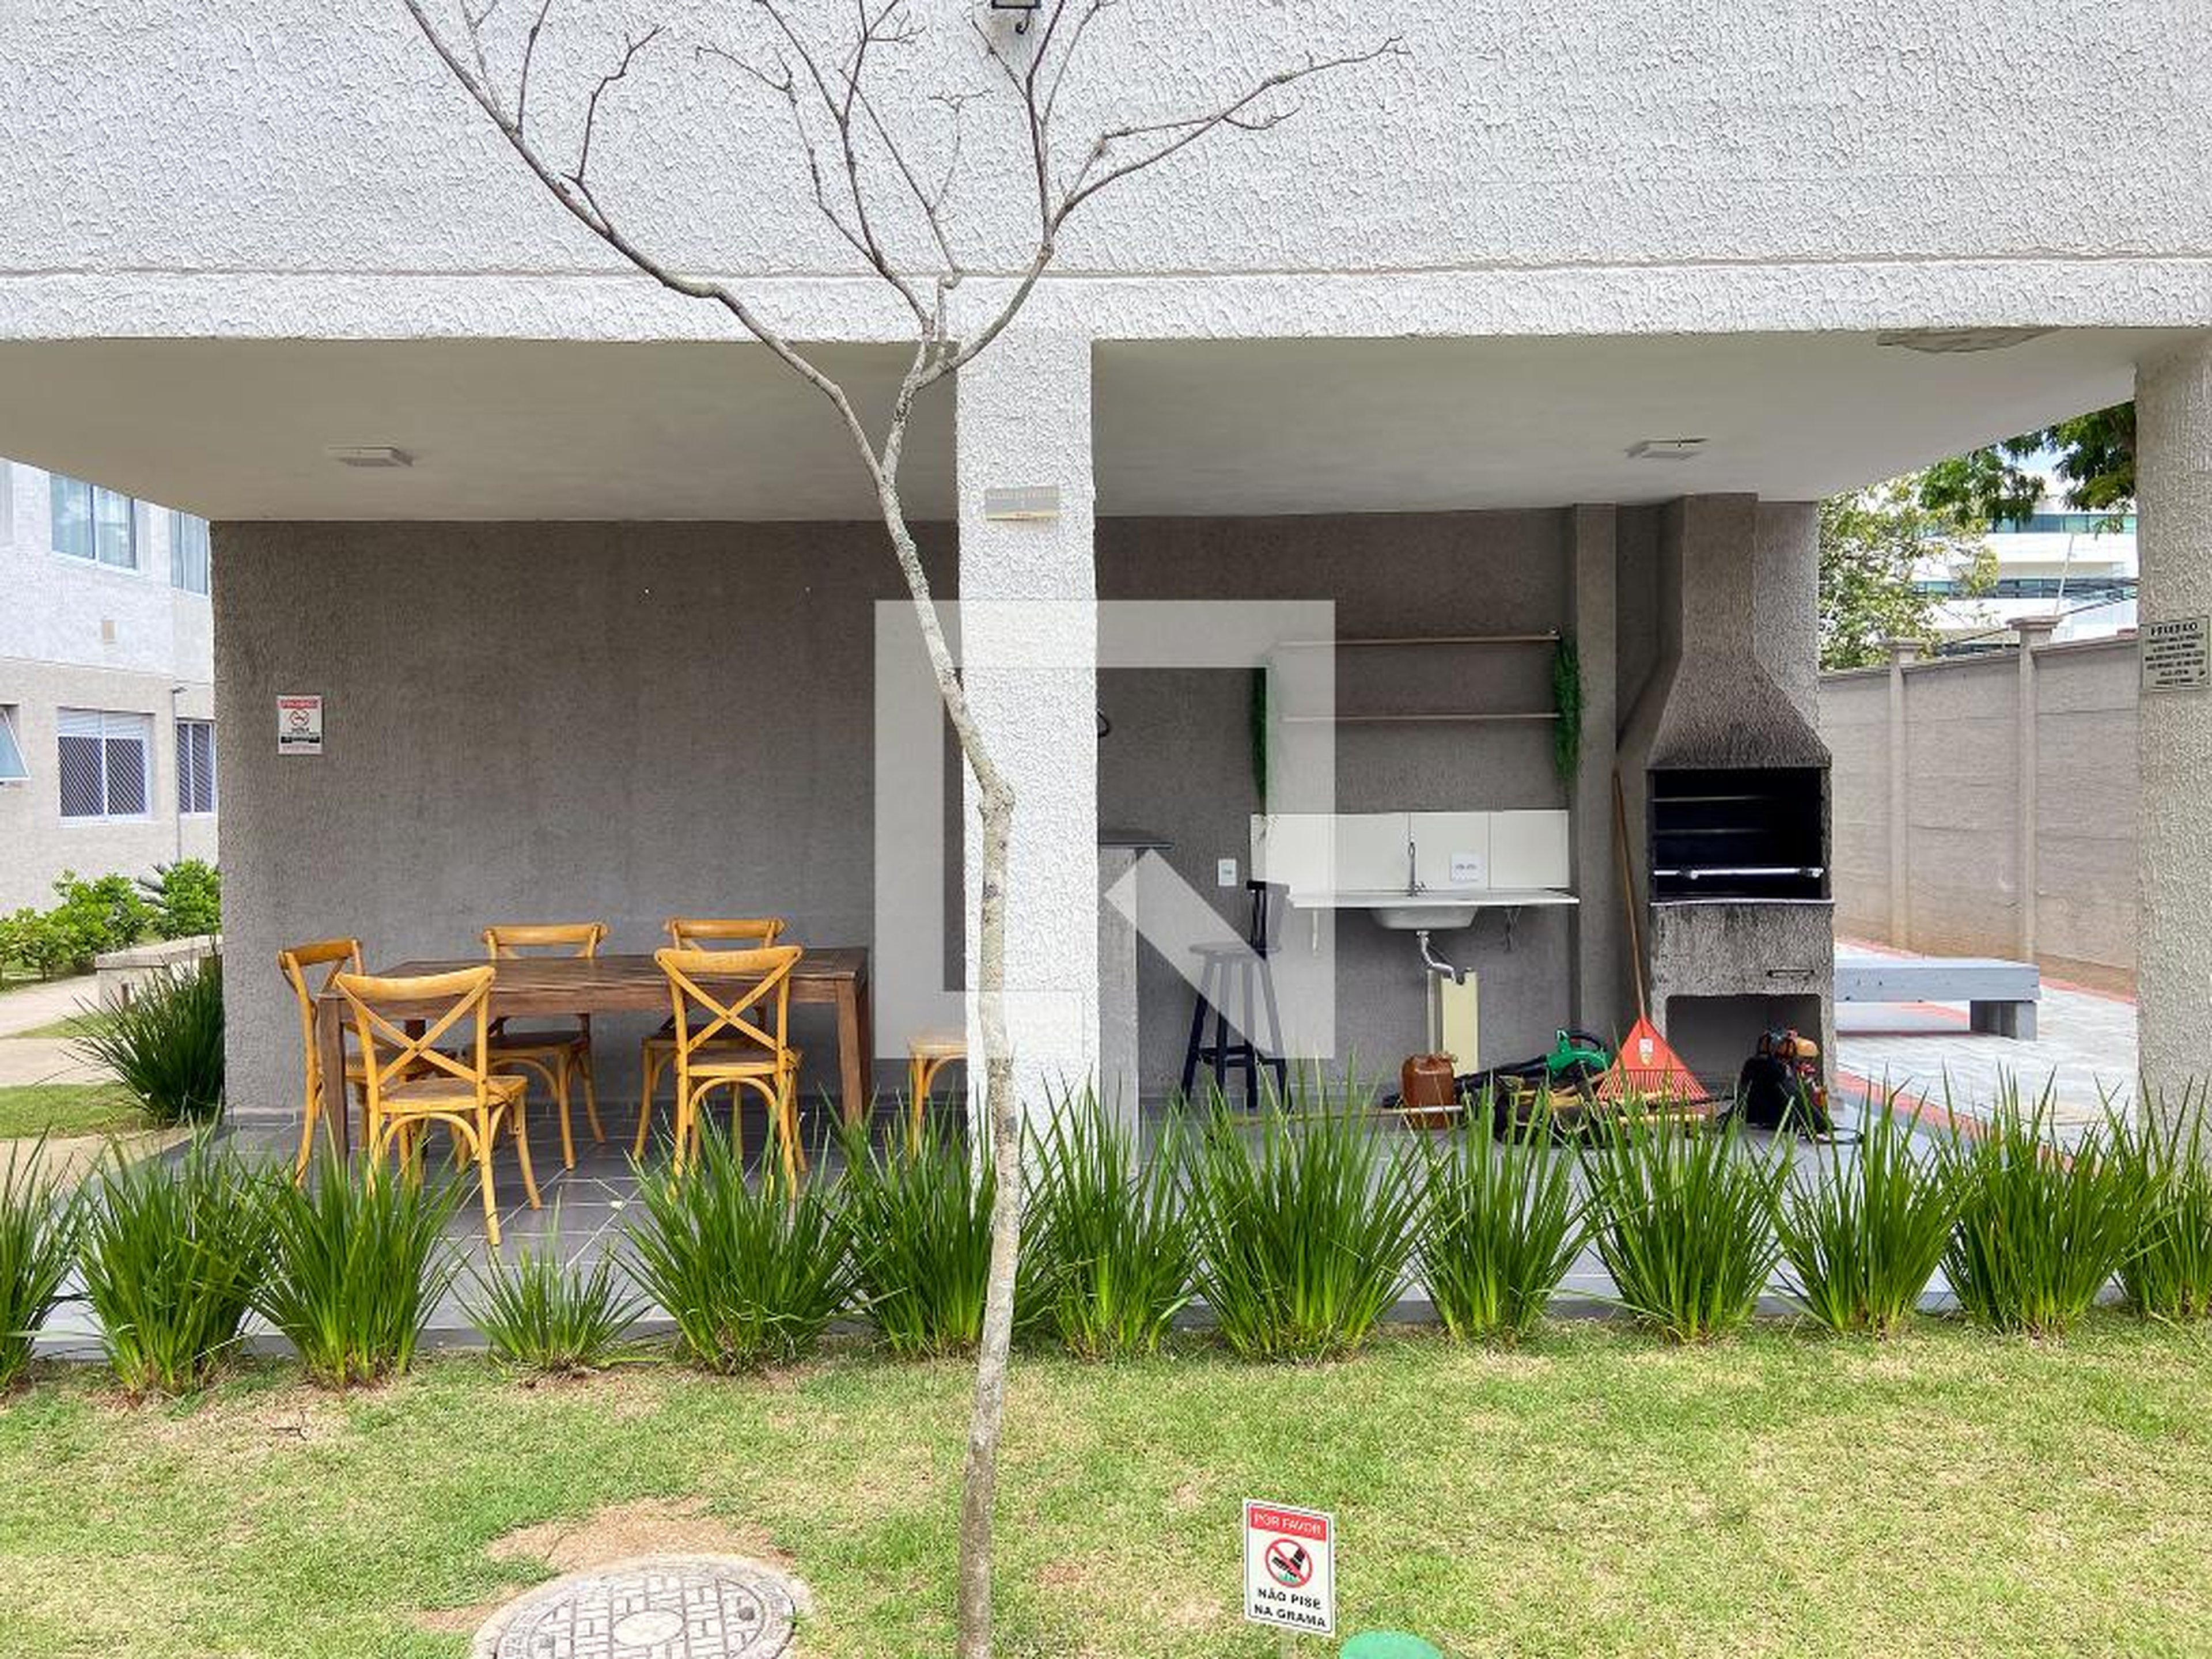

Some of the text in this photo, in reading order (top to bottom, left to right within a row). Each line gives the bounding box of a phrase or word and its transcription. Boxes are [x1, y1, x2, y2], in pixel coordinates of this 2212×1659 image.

[1254, 1513, 1321, 1535] POR FAVOR
[1258, 1588, 1321, 1610] NÃO PISE
[1255, 1604, 1326, 1627] NA GRAMA
